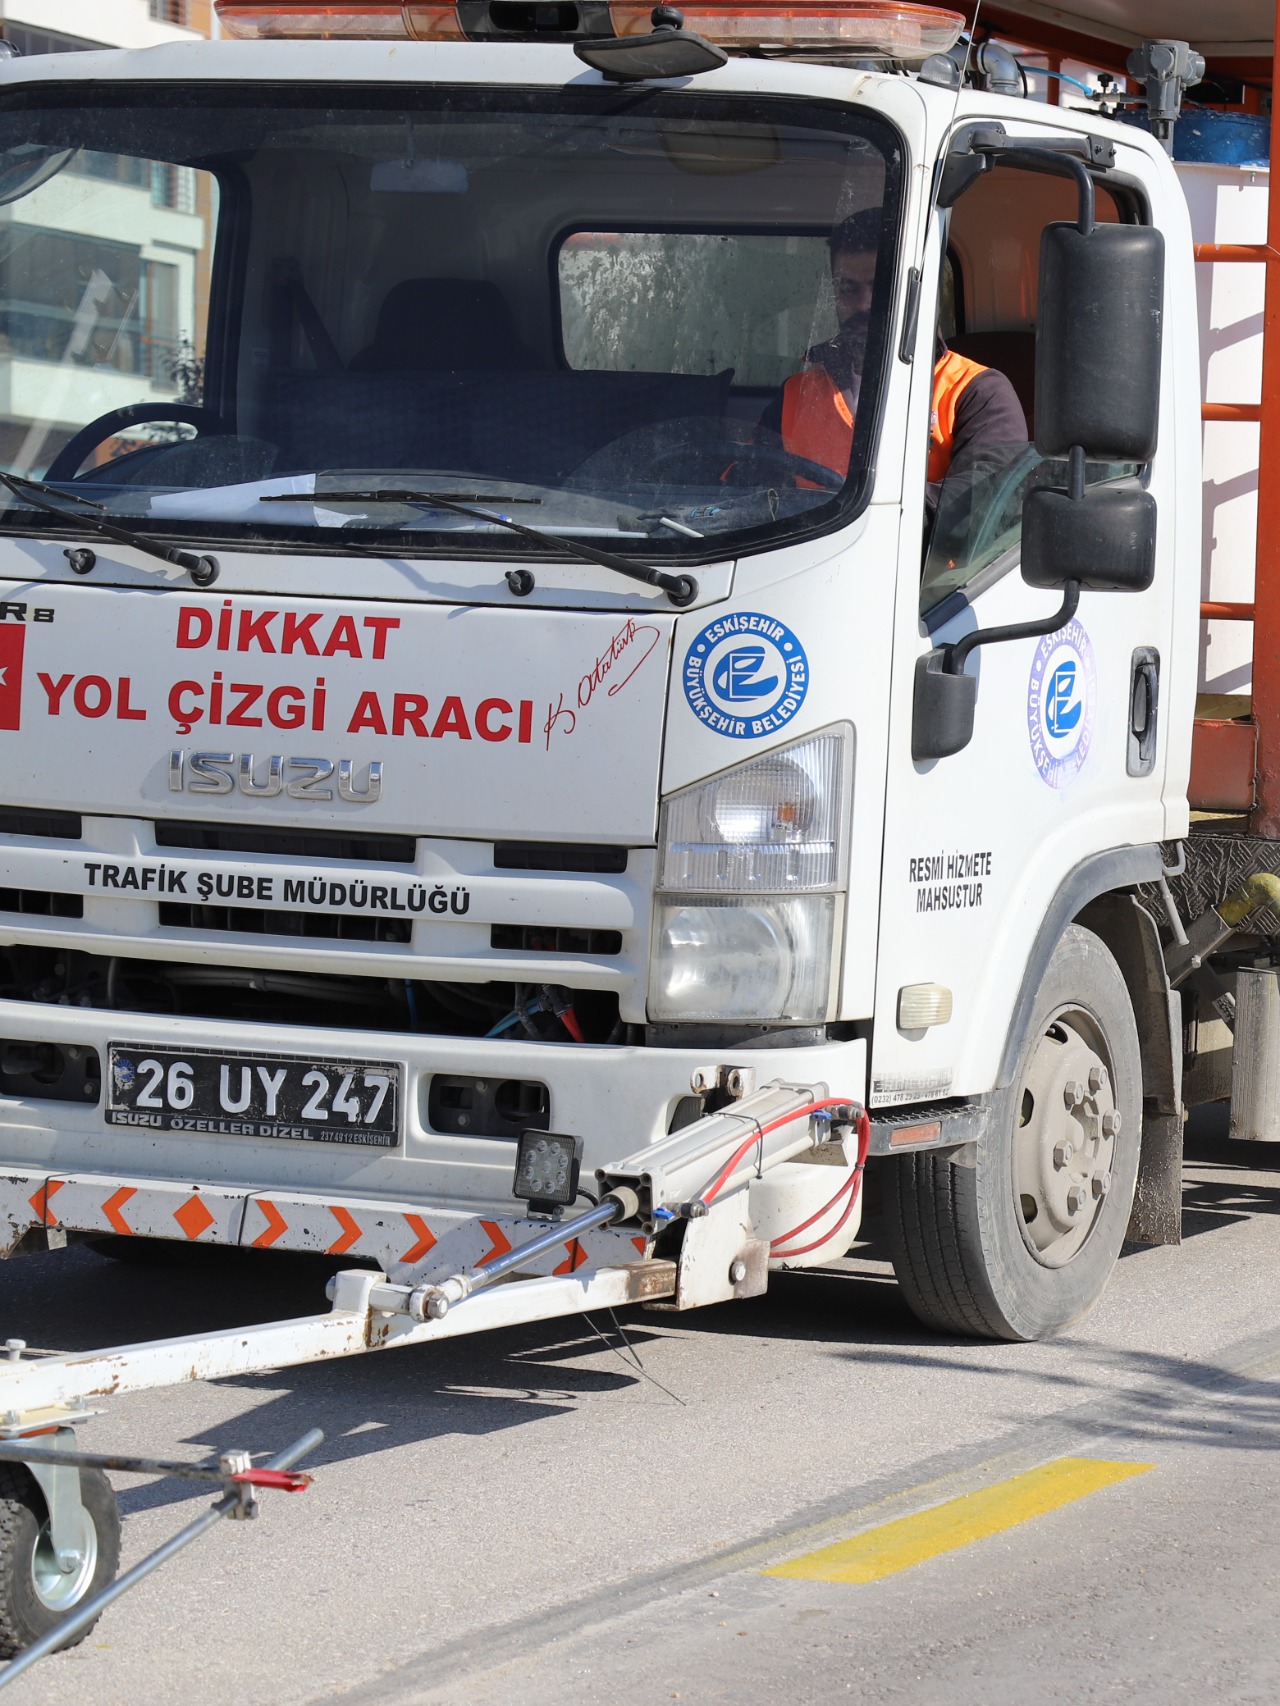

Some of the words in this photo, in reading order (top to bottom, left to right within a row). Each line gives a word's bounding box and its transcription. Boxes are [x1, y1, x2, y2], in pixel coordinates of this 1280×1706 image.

[33, 608, 55, 623] 8
[176, 600, 400, 659] DİKKAT
[704, 614, 785, 643] ESKİŞEHİR
[37, 671, 147, 721] YOL
[168, 671, 325, 736] ÇİZGİ
[346, 692, 533, 743] ARACI
[686, 655, 746, 735] BÜYÜKŞEHİR
[751, 655, 806, 735] BELEDİYESİ
[168, 749, 384, 803] ISUZU
[84, 863, 187, 895] TRAFİK
[196, 872, 274, 902] ŞUBE
[283, 881, 471, 915] MÜDÜRLÜĞÜ
[909, 849, 944, 883] RESMİ
[947, 848, 992, 879] HİZMETE
[916, 882, 983, 913] MAHSUSTUR
[136, 1058, 195, 1110] 26
[219, 1064, 288, 1117] UY
[301, 1071, 390, 1123] 247
[111, 1112, 162, 1127] ISUZU
[170, 1116, 255, 1136] ÖZELLER
[259, 1123, 314, 1140] DİZEL
